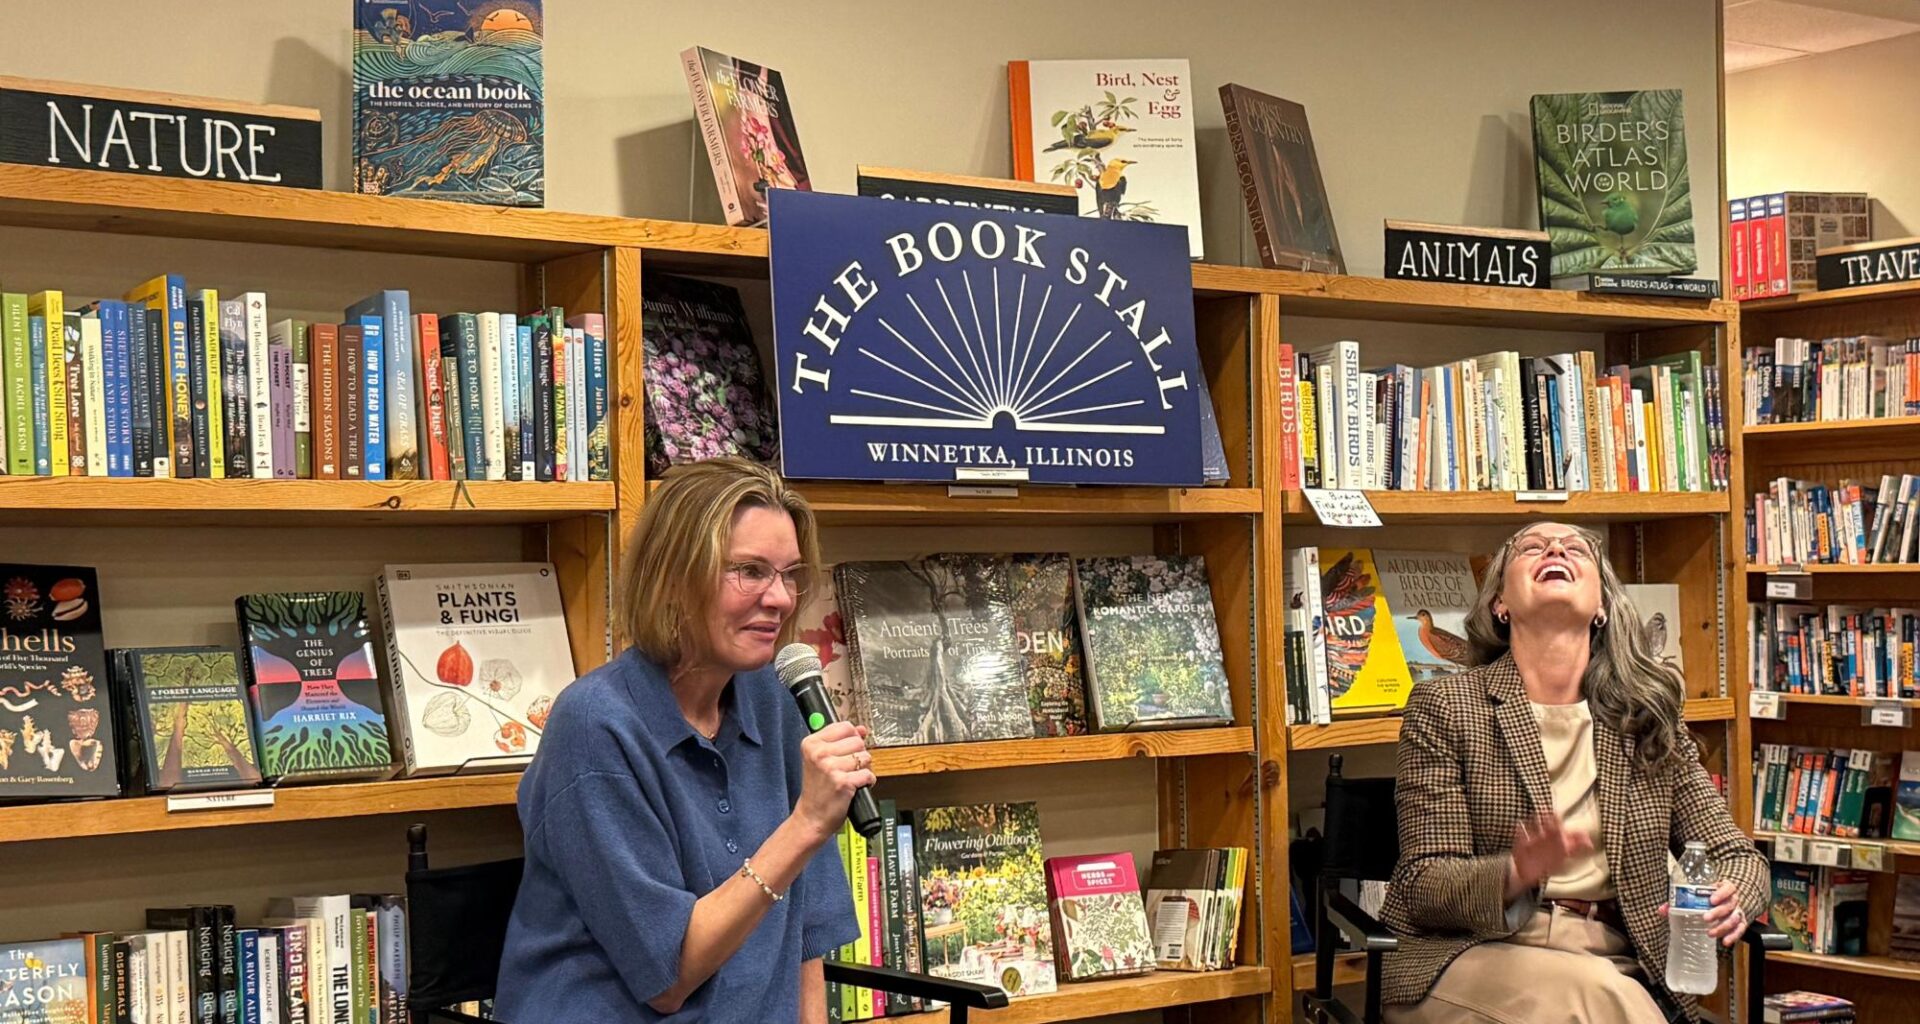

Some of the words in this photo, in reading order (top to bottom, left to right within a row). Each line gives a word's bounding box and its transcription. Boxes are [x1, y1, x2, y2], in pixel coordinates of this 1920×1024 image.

[369, 82, 403, 98] the
[408, 84, 471, 99] ocean
[477, 83, 531, 100] book
[1095, 72, 1136, 88] Bird,
[1141, 72, 1179, 87] Nest
[1163, 88, 1181, 101] &
[1148, 100, 1182, 119] Egg
[47, 101, 281, 184] NATURE
[704, 118, 724, 166] FARMERS
[1556, 120, 1670, 145] BIRDER'S
[1572, 146, 1658, 168] ATLAS
[1225, 111, 1245, 162] HORSE
[1238, 162, 1266, 234] COUNTRY
[1565, 170, 1668, 193] WORLD
[1397, 240, 1539, 287] ANIMALS
[1650, 281, 1668, 290] ATLAS
[1683, 284, 1706, 292] WORLD
[791, 260, 880, 395] THE
[885, 219, 1048, 277] BOOK
[1064, 246, 1189, 410] STALL
[50, 321, 62, 349] Dead
[173, 321, 185, 369] BITTER
[465, 320, 476, 356] CLOSE
[538, 331, 548, 356] Night
[14, 337, 23, 368] SPRING
[104, 329, 114, 377] SHELTER
[117, 331, 127, 378] SHELTER
[209, 321, 217, 376] BREADFRUIT
[236, 350, 244, 365] The
[323, 343, 331, 365] THE
[347, 348, 356, 374] HOW
[367, 350, 378, 371] HOW
[52, 353, 63, 382] Bees
[69, 364, 80, 390] Tree
[368, 373, 378, 385] TO
[427, 358, 441, 390] Seed
[468, 359, 477, 373] TO
[538, 358, 550, 387] Magic
[555, 350, 565, 386] GROWING
[236, 366, 246, 393] Savage
[323, 368, 332, 411] HIDDEN
[348, 376, 357, 391] TO
[396, 370, 406, 390] SEA
[1345, 349, 1358, 411] SIBLEY
[1763, 366, 1771, 397] Greece
[15, 377, 25, 410] RACHEL
[71, 392, 82, 418] Lore
[106, 382, 115, 404] AND
[119, 383, 128, 405] AND
[175, 373, 188, 420] HONEY
[368, 388, 379, 411] READ
[398, 393, 407, 410] OF
[469, 377, 480, 410] HOME
[556, 389, 565, 419] PAPAYA
[595, 387, 605, 417] Julian
[1279, 367, 1295, 434] BIRDS
[1366, 380, 1374, 420] SIBLEY
[237, 395, 246, 437] Landscape
[348, 394, 357, 421] READ
[17, 415, 27, 452] CARSON
[53, 412, 66, 440] Sting
[107, 407, 117, 444] STORM
[120, 409, 130, 444] STORM
[368, 414, 379, 444] WATER
[399, 412, 409, 448] GRASS
[429, 405, 442, 437] Dust
[324, 414, 333, 461] SEASONS
[349, 434, 358, 460] TREE
[1348, 415, 1360, 467] BIRDS
[1366, 430, 1374, 463] BIRDS
[867, 441, 1018, 469] WINNETKA,
[1025, 446, 1135, 468] ILLINOIS
[1387, 559, 1467, 575] AUDUBON'S
[436, 583, 515, 591] SMITHSONIAN
[1399, 575, 1442, 591] BIRDS
[1444, 575, 1464, 591] OF
[437, 591, 517, 608] PLANTS
[1093, 605, 1155, 616] ROMANTIC
[1158, 604, 1206, 614] GARDEN
[1121, 593, 1144, 602] THE
[1147, 592, 1169, 601] NEW
[1404, 593, 1470, 609] AMERICA
[441, 610, 454, 624] &
[460, 609, 520, 624] FUNGI
[880, 620, 941, 638] Ancient
[948, 618, 989, 635] Trees
[303, 639, 323, 647] THE
[377, 575, 392, 634] PLANTS
[389, 645, 401, 690] FUNGI
[30, 654, 69, 663] Thousand
[295, 648, 334, 658] GENIUS
[309, 658, 323, 667] OF
[883, 646, 930, 659] Portraits
[949, 643, 959, 656] of
[18, 663, 47, 671] Species
[302, 668, 333, 677] TREES
[192, 686, 236, 694] LANGUAGE
[293, 713, 336, 722] HARRIET
[339, 712, 356, 721] RIX
[977, 713, 996, 721] Beth
[884, 817, 895, 845] BIRD
[924, 835, 984, 852] Flowering
[887, 848, 897, 887] HAVEN
[1081, 871, 1105, 880] HERBS
[1086, 878, 1113, 886] SPICES
[1776, 878, 1806, 891] BELIZE
[889, 889, 899, 918] FARM
[9, 949, 34, 960] The
[200, 926, 212, 976] Noticing
[223, 925, 234, 974] Noticing
[245, 937, 254, 948] IS
[246, 951, 254, 959] A
[0, 963, 79, 981] TERFLY
[116, 951, 126, 1016] DISPERSALS
[247, 962, 255, 995] RIVER
